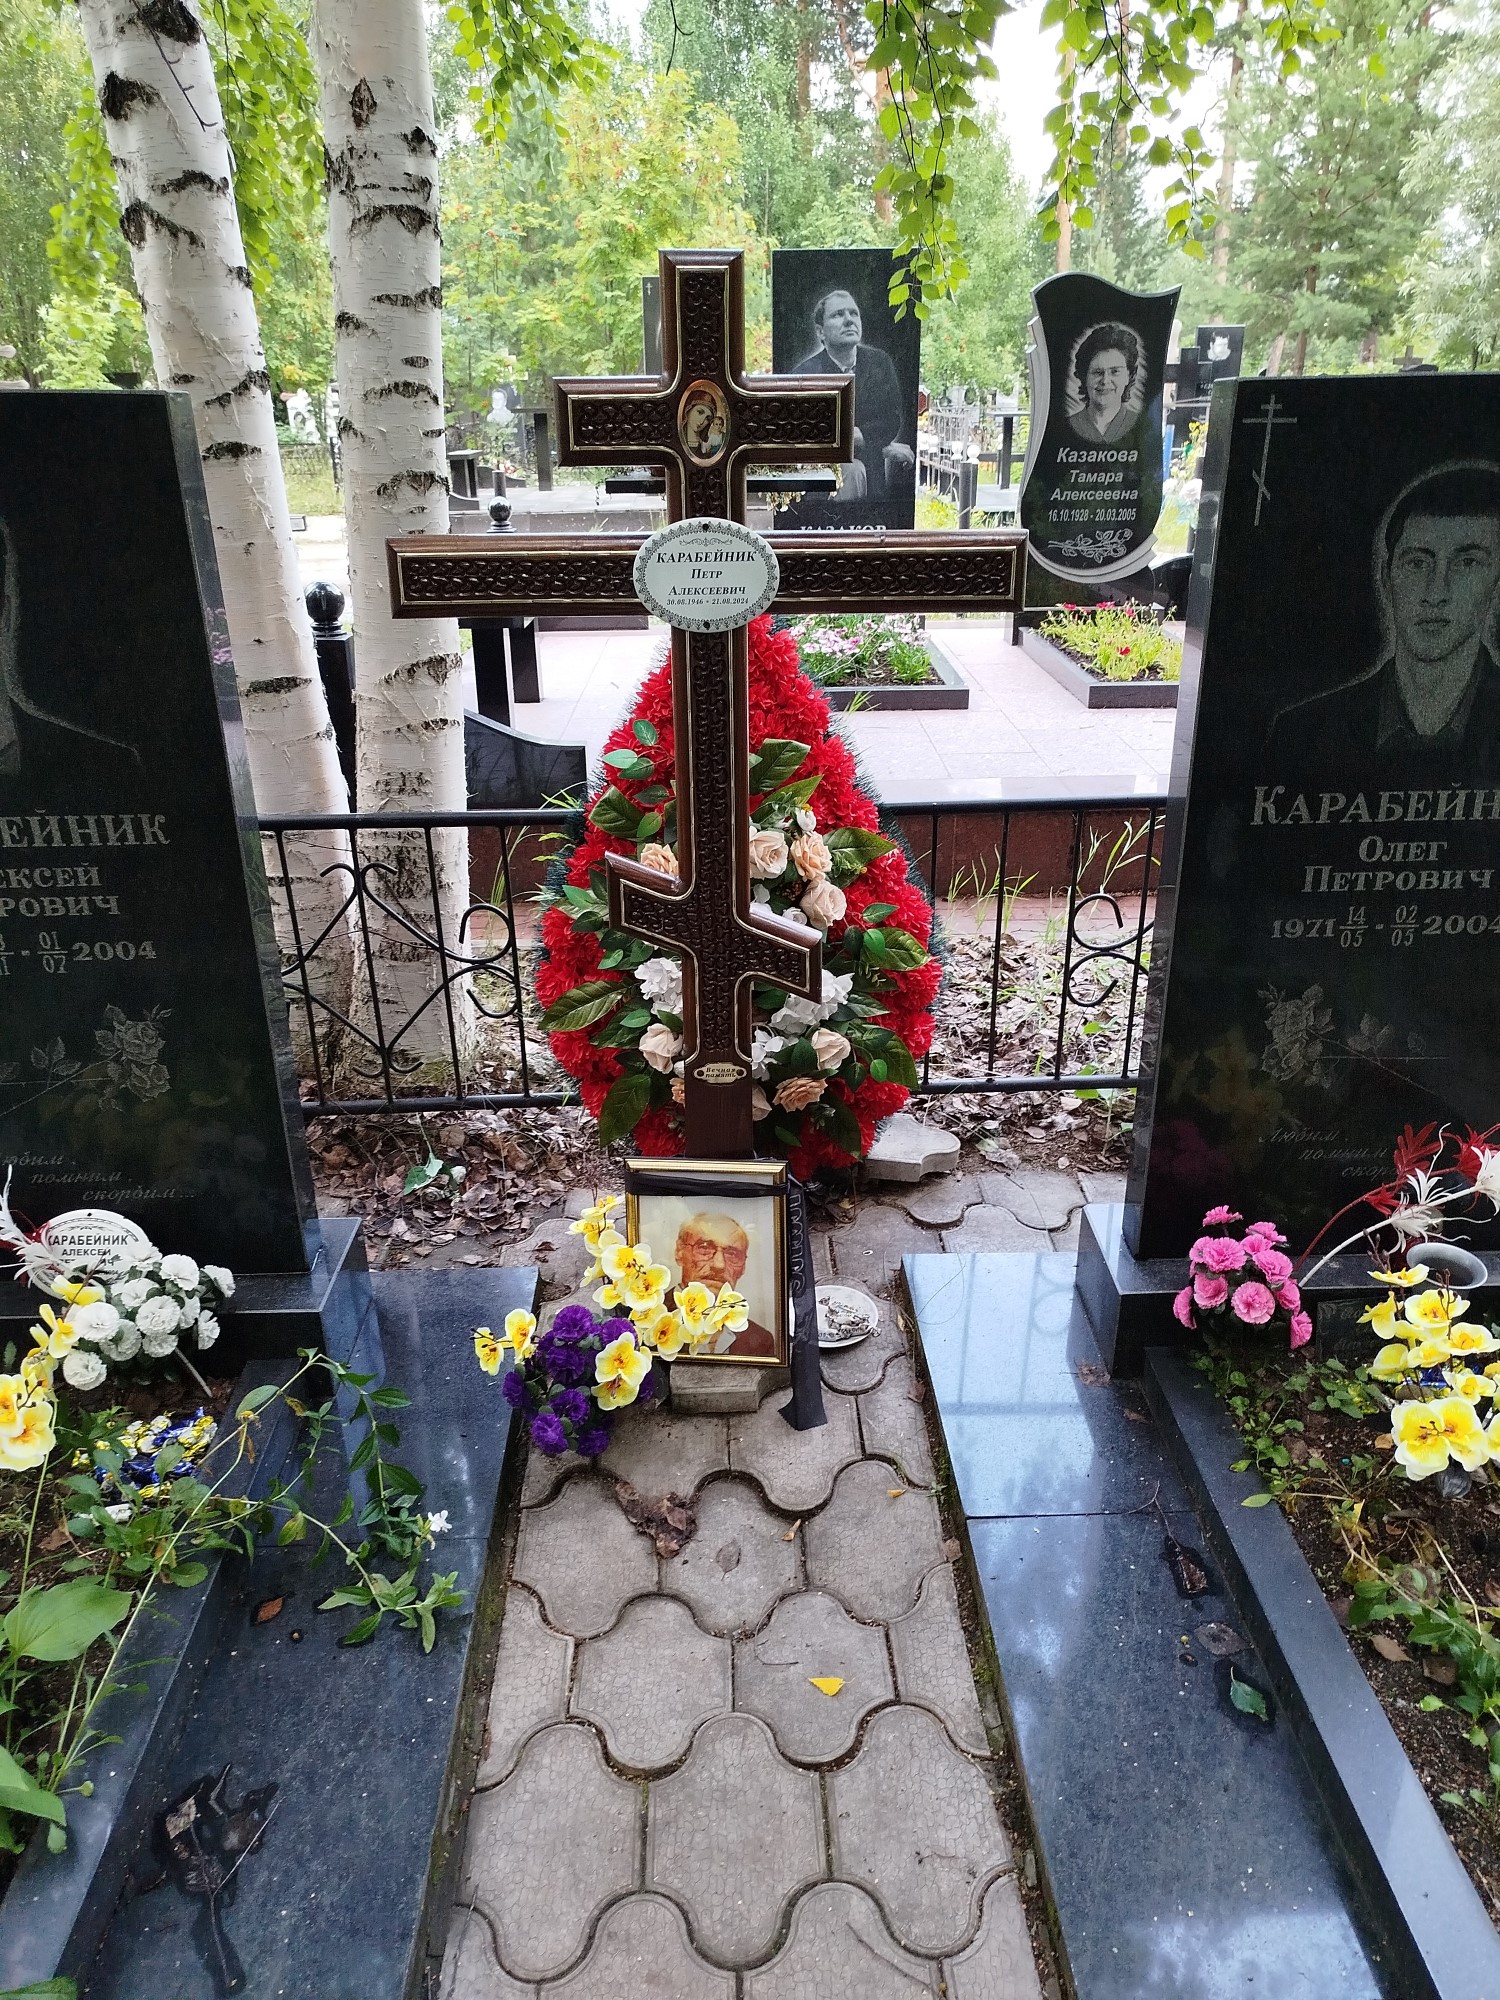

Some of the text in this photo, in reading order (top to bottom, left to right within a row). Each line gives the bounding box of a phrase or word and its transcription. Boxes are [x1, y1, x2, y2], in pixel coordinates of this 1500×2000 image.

[1056, 447, 1139, 463] Казакова
[1069, 470, 1124, 486] Тамара
[1050, 488, 1139, 501] Алексеевна
[1048, 509, 1089, 522] 16.10.1928
[1094, 508, 1137, 522] 20.03.2005
[655, 549, 757, 564] КАРАБЕЙНИК
[690, 568, 723, 579] ПЕТР
[668, 586, 746, 596] АЛЕКСЕЕВИЧ
[1358, 836, 1448, 863] ОЛЕГ
[1301, 865, 1495, 893] ПЕТРОВИЧ
[1271, 918, 1337, 938] 1971
[72, 940, 157, 961] 2004
